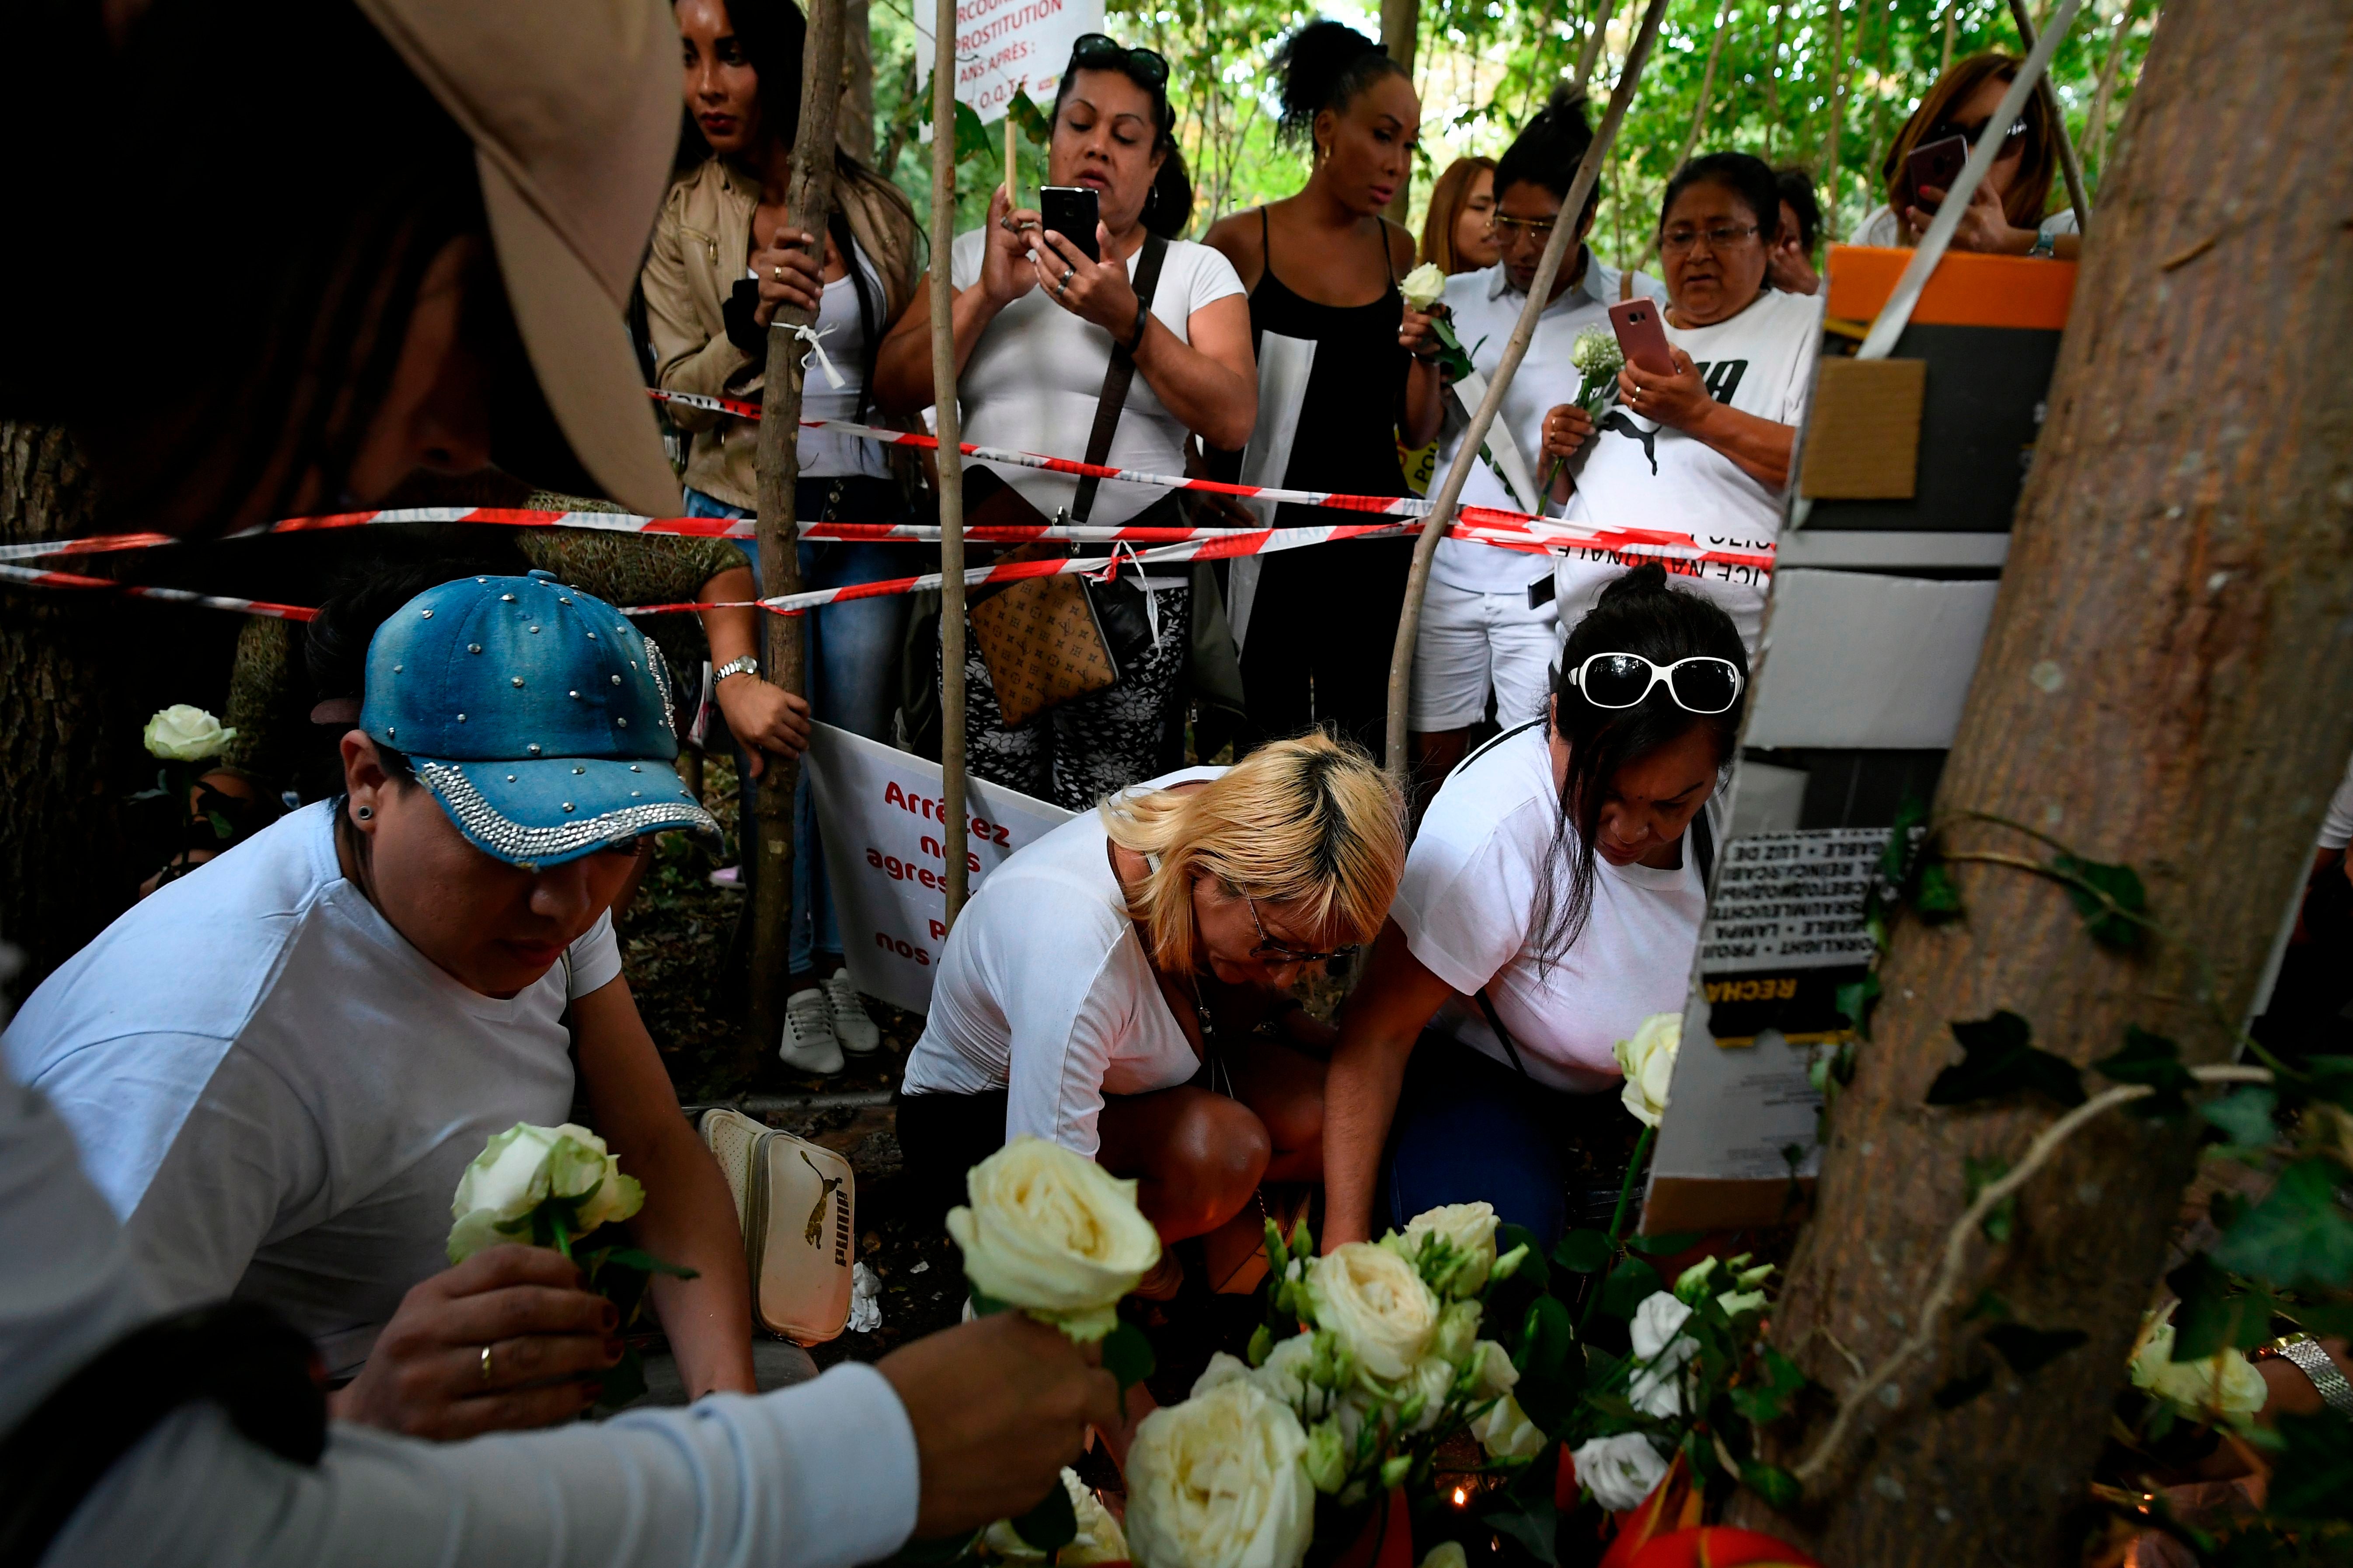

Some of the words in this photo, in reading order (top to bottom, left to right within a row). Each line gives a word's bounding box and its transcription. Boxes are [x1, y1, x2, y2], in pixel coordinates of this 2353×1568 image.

[955, 0, 1062, 52] PROSTITUTION
[988, 41, 1028, 71] APRÈS
[885, 781, 1010, 848] Arrez
[920, 836, 980, 872] ns
[875, 932, 930, 965] nos
[835, 1189, 850, 1267] PUMA
